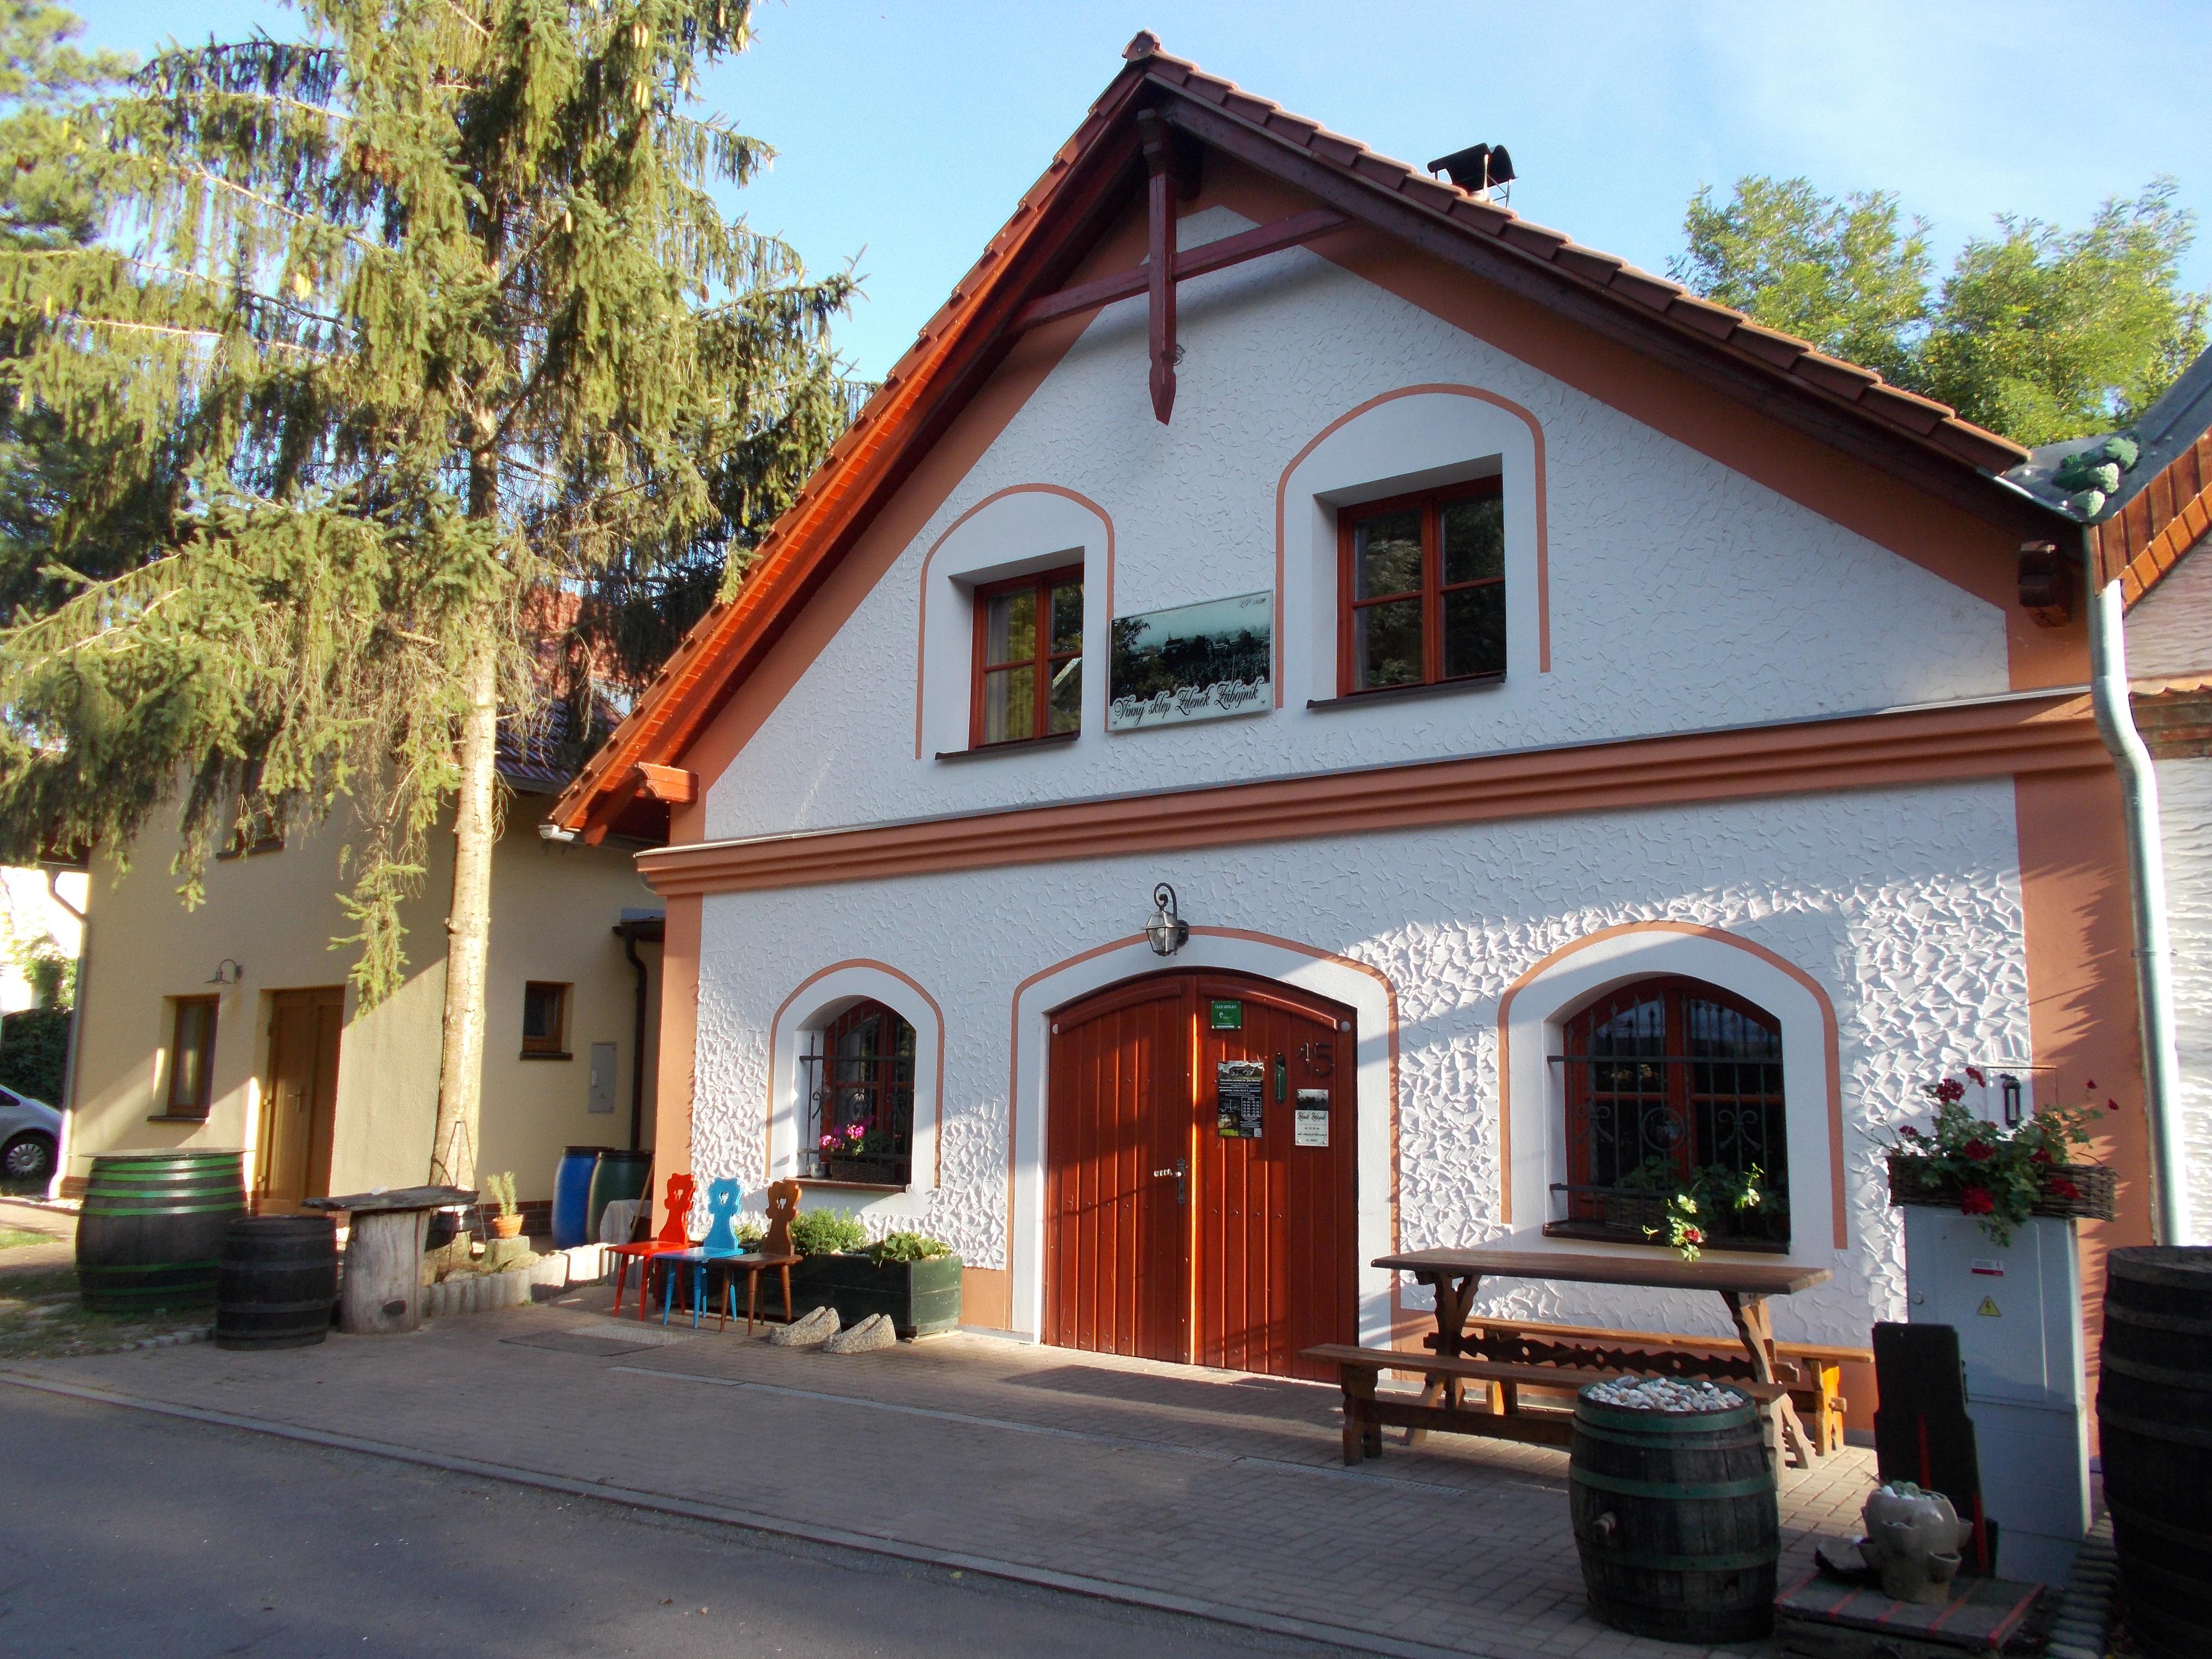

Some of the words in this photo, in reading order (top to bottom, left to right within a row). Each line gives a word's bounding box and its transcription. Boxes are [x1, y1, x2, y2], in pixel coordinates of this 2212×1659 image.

[1114, 696, 1146, 726] Vinný
[1148, 692, 1171, 719] sklep
[1296, 1042, 1335, 1078] 15
